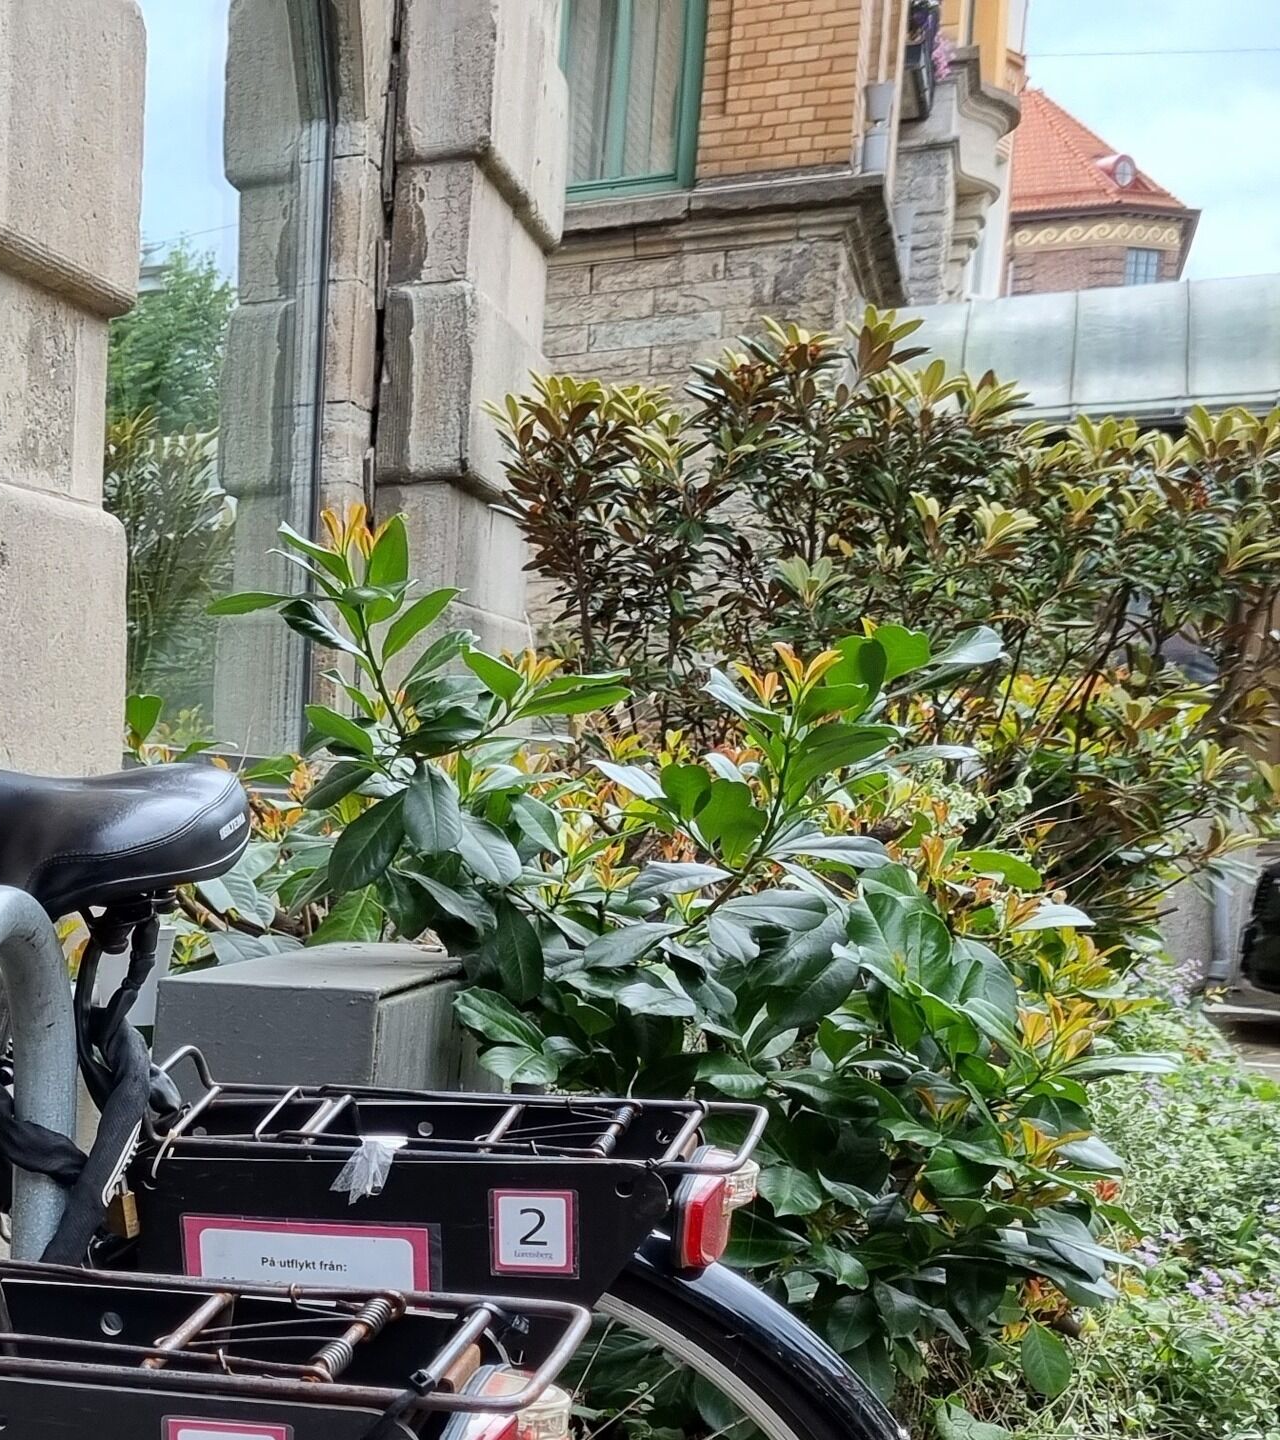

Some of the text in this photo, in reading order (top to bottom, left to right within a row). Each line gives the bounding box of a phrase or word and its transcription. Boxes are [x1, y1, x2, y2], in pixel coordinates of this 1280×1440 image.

[519, 1207, 548, 1246] 2
[261, 1256, 348, 1273] På utflykt från:
